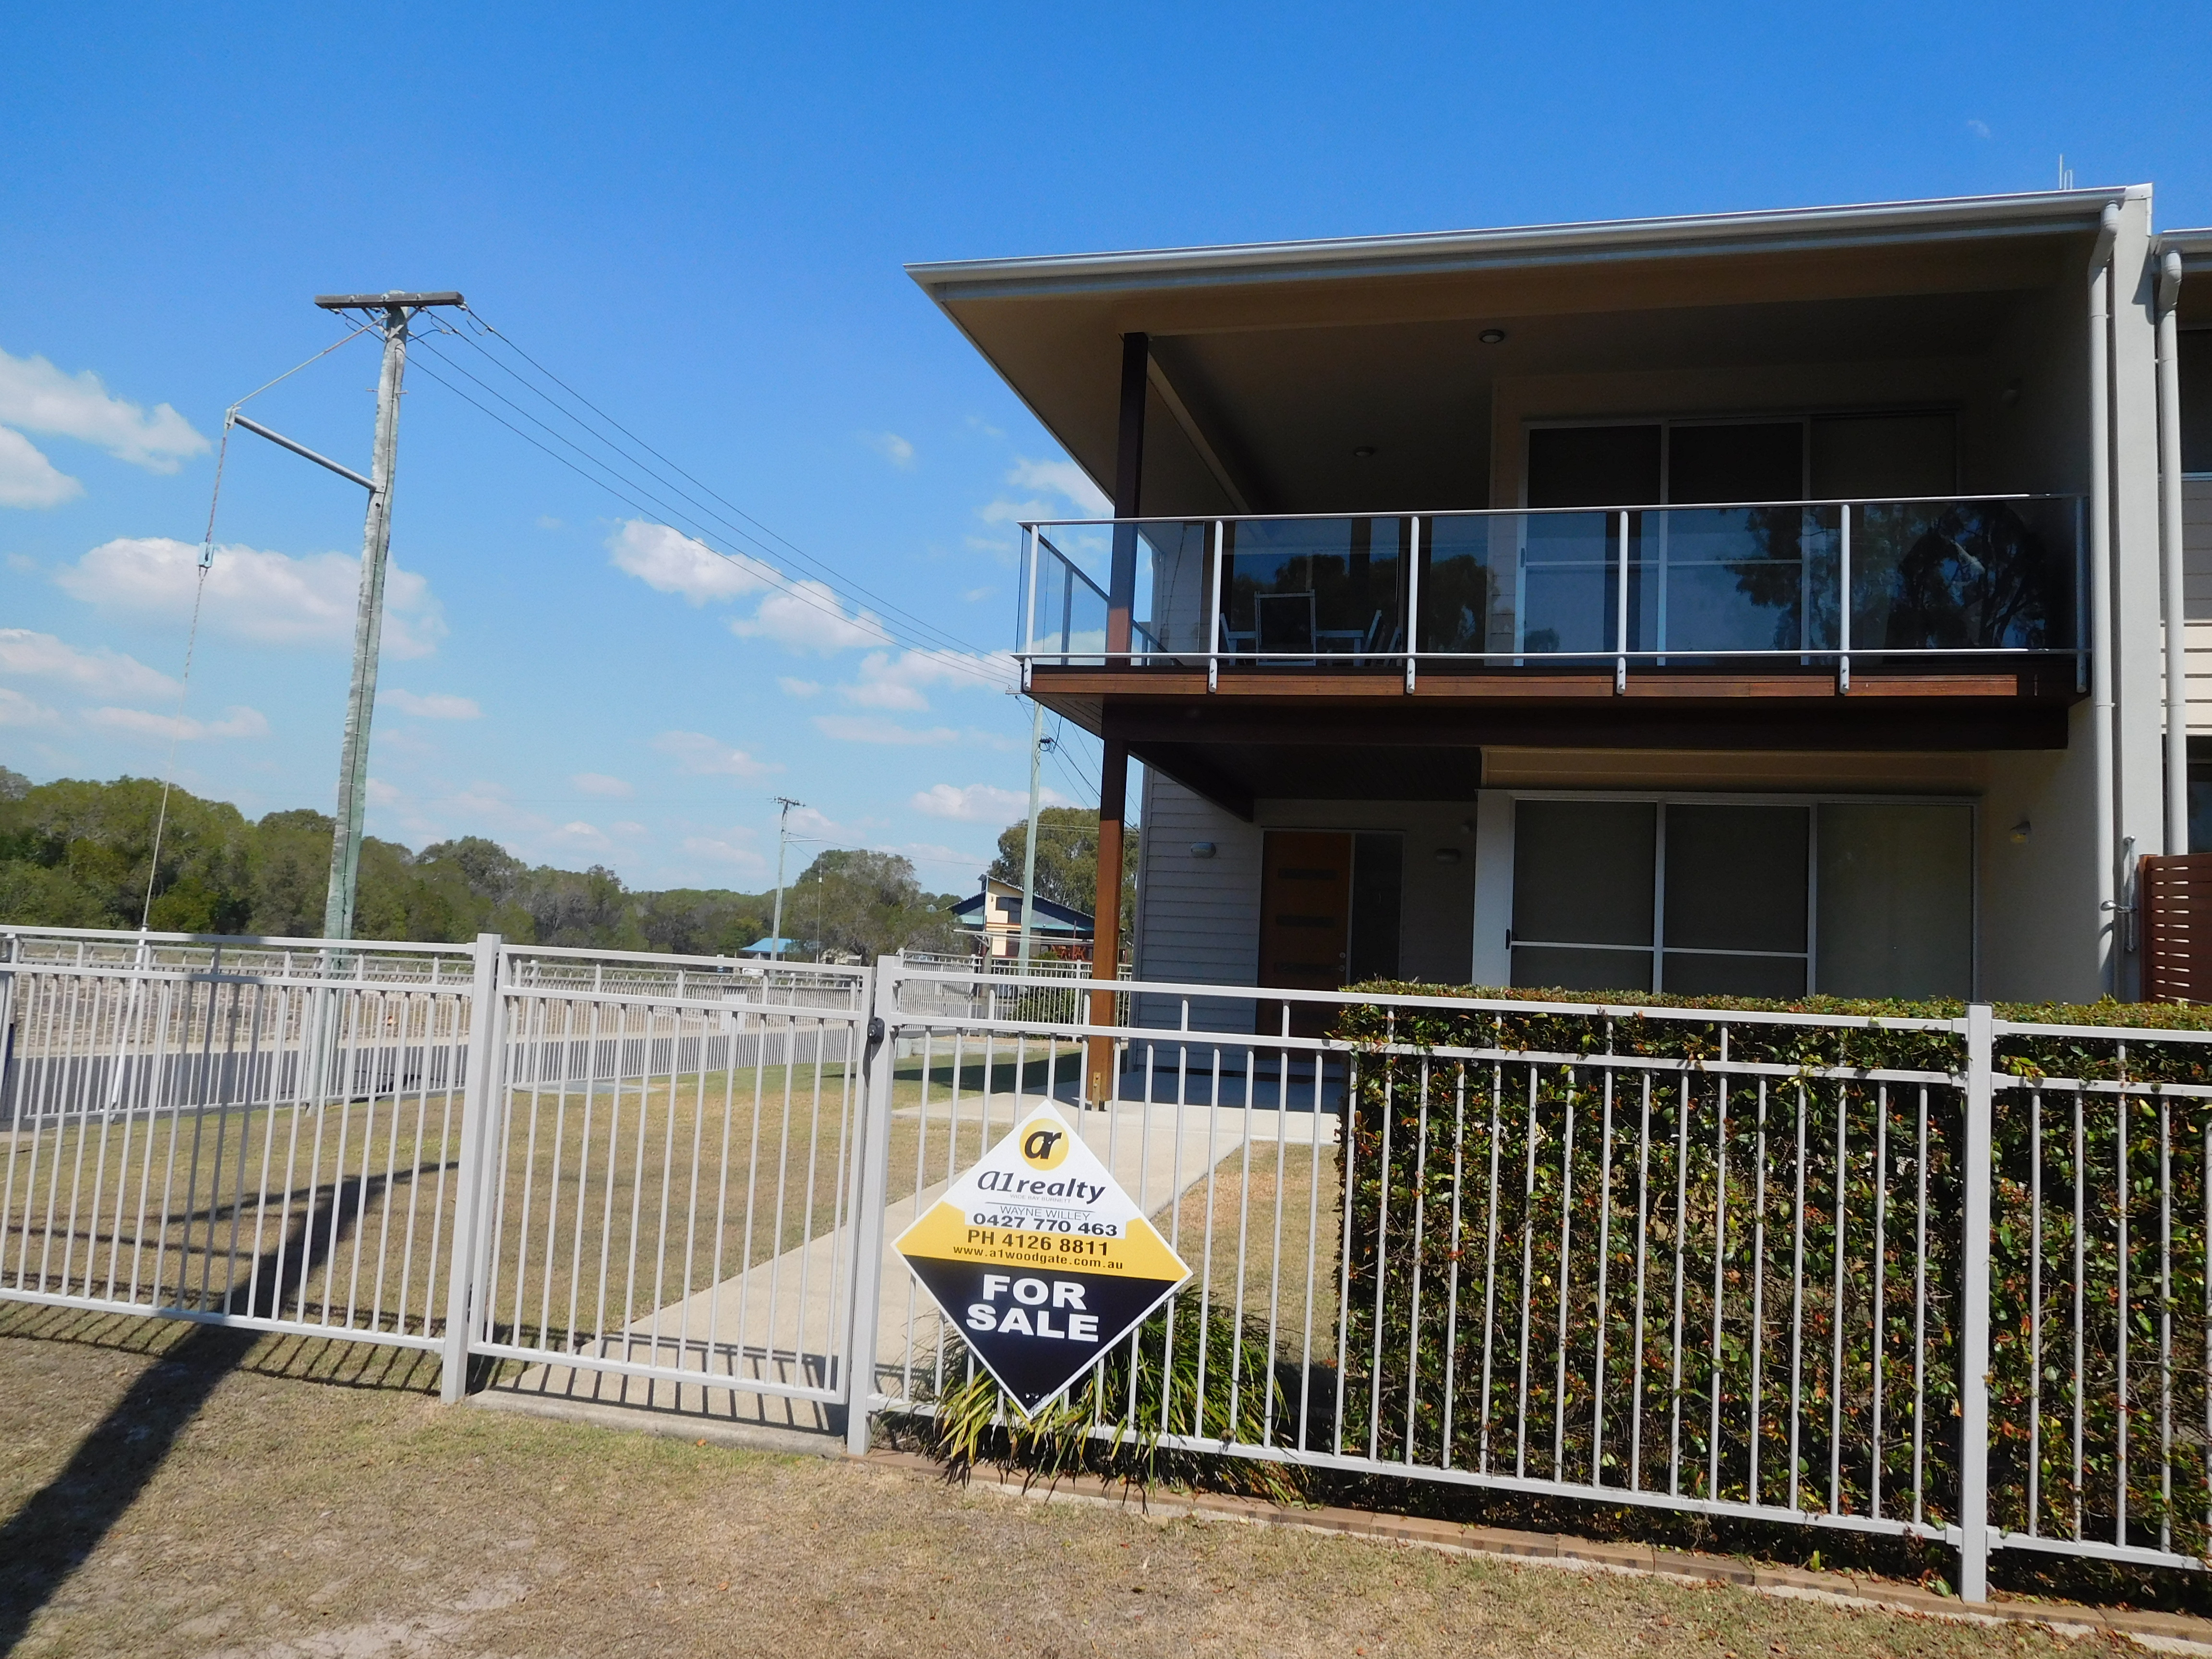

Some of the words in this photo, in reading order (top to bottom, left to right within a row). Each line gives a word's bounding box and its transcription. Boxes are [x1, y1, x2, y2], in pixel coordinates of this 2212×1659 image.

[974, 1213, 1026, 1228] 0427
[1033, 1218, 1071, 1233] 770
[1077, 1222, 1118, 1237] 463
[1000, 1205, 1043, 1217] WAYNE
[1046, 1209, 1091, 1221] WILLEY
[967, 1229, 995, 1246] PH
[1002, 1233, 1052, 1250] 4126
[1059, 1238, 1107, 1256] 8811
[953, 1246, 1123, 1270] www.a1woodgate.com.au
[983, 1274, 1087, 1310] FOR
[966, 1303, 1099, 1343] SALE
